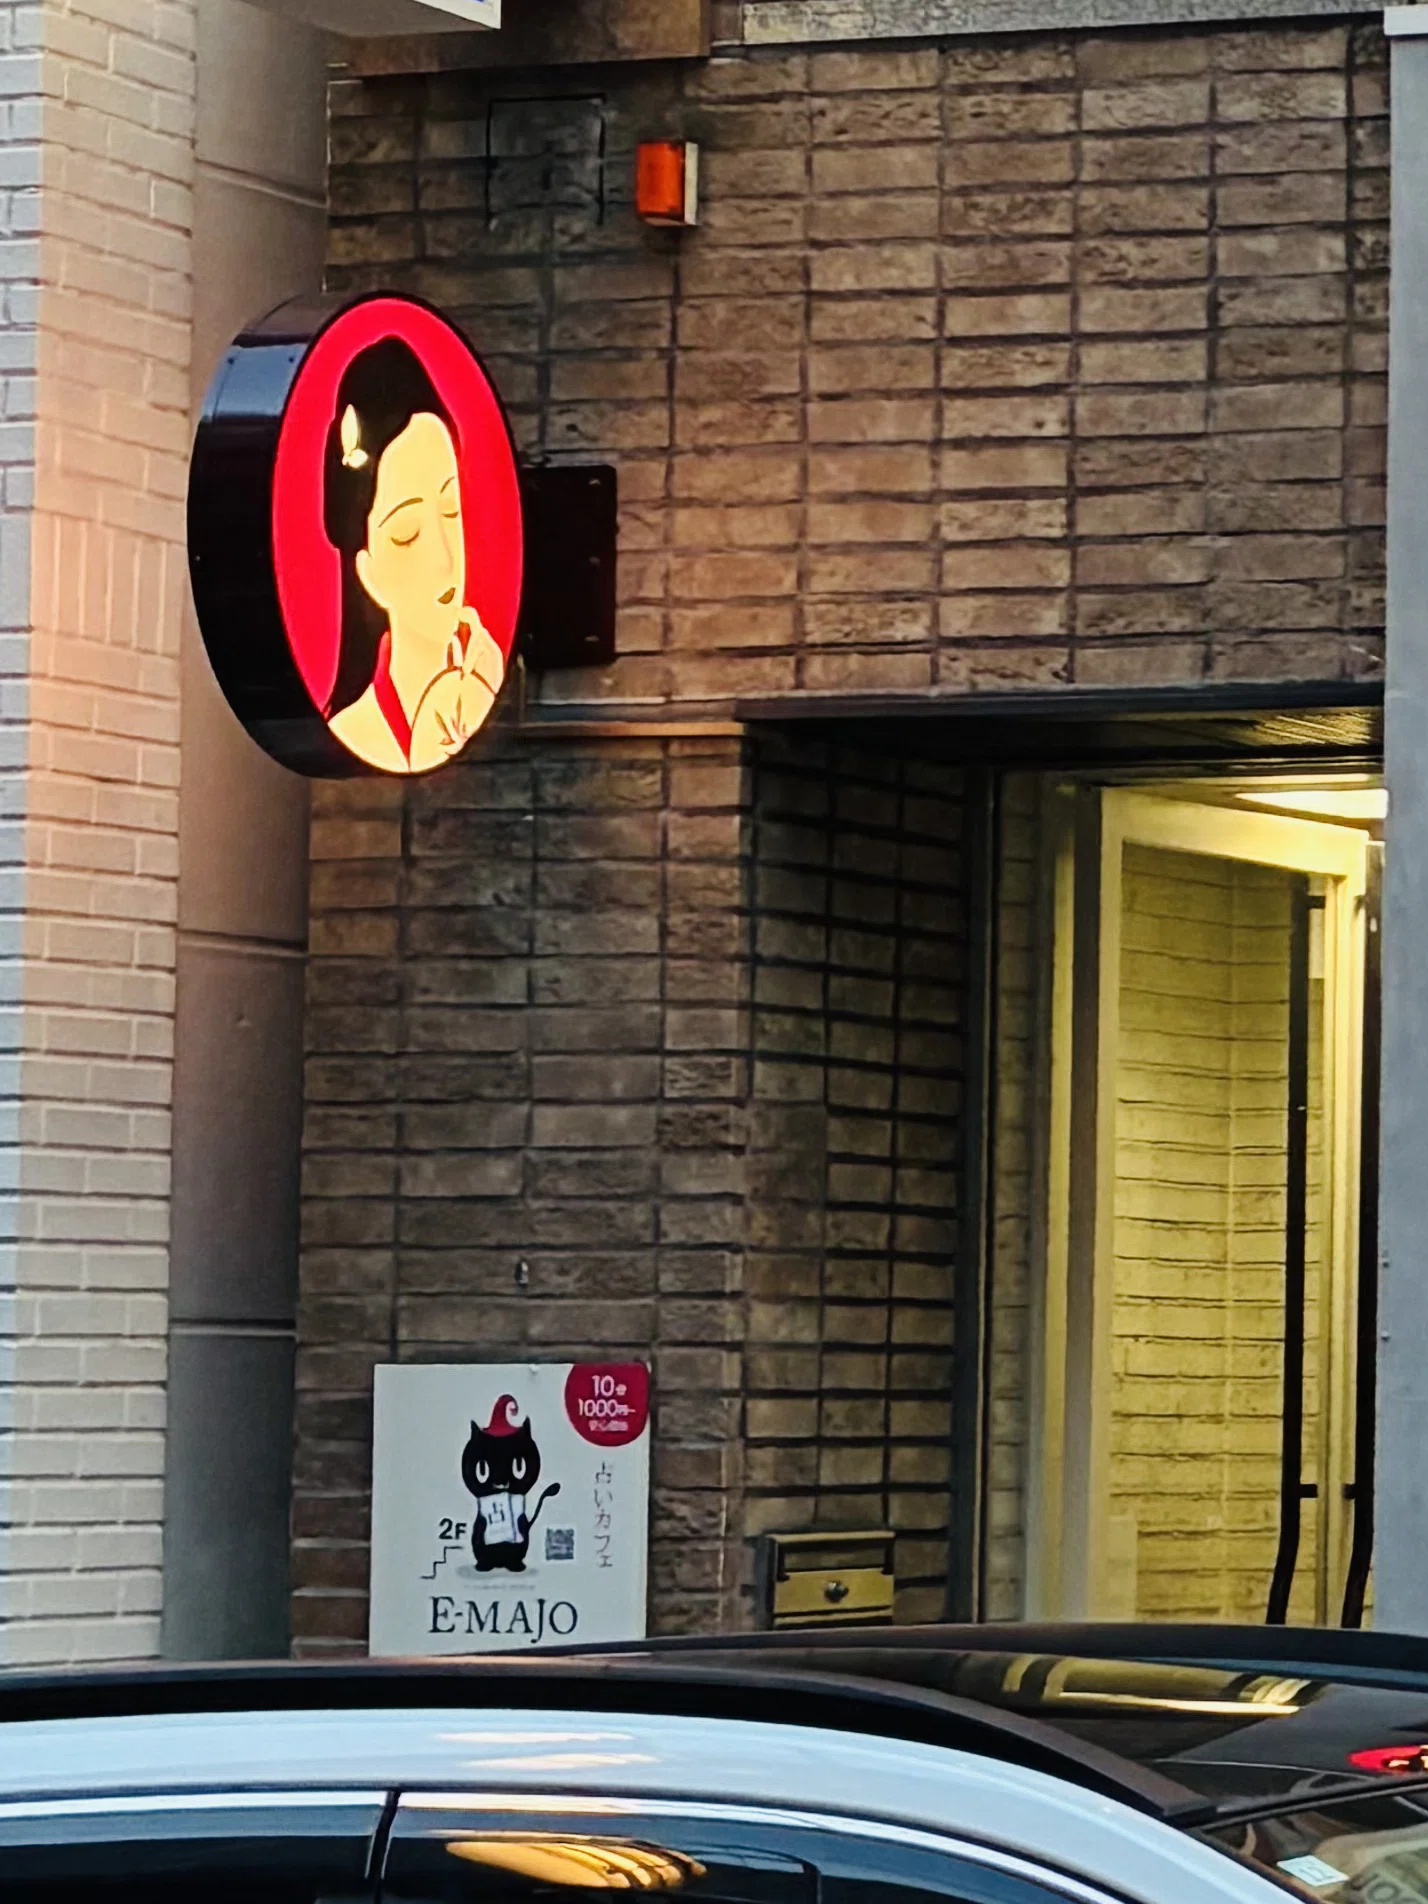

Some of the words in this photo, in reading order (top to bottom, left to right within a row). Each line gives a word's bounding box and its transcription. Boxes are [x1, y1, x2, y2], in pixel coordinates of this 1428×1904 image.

[438, 1517, 467, 1540] 2F
[593, 1460, 614, 1569] 占いカフェ
[428, 1596, 578, 1644] E-MAJO
